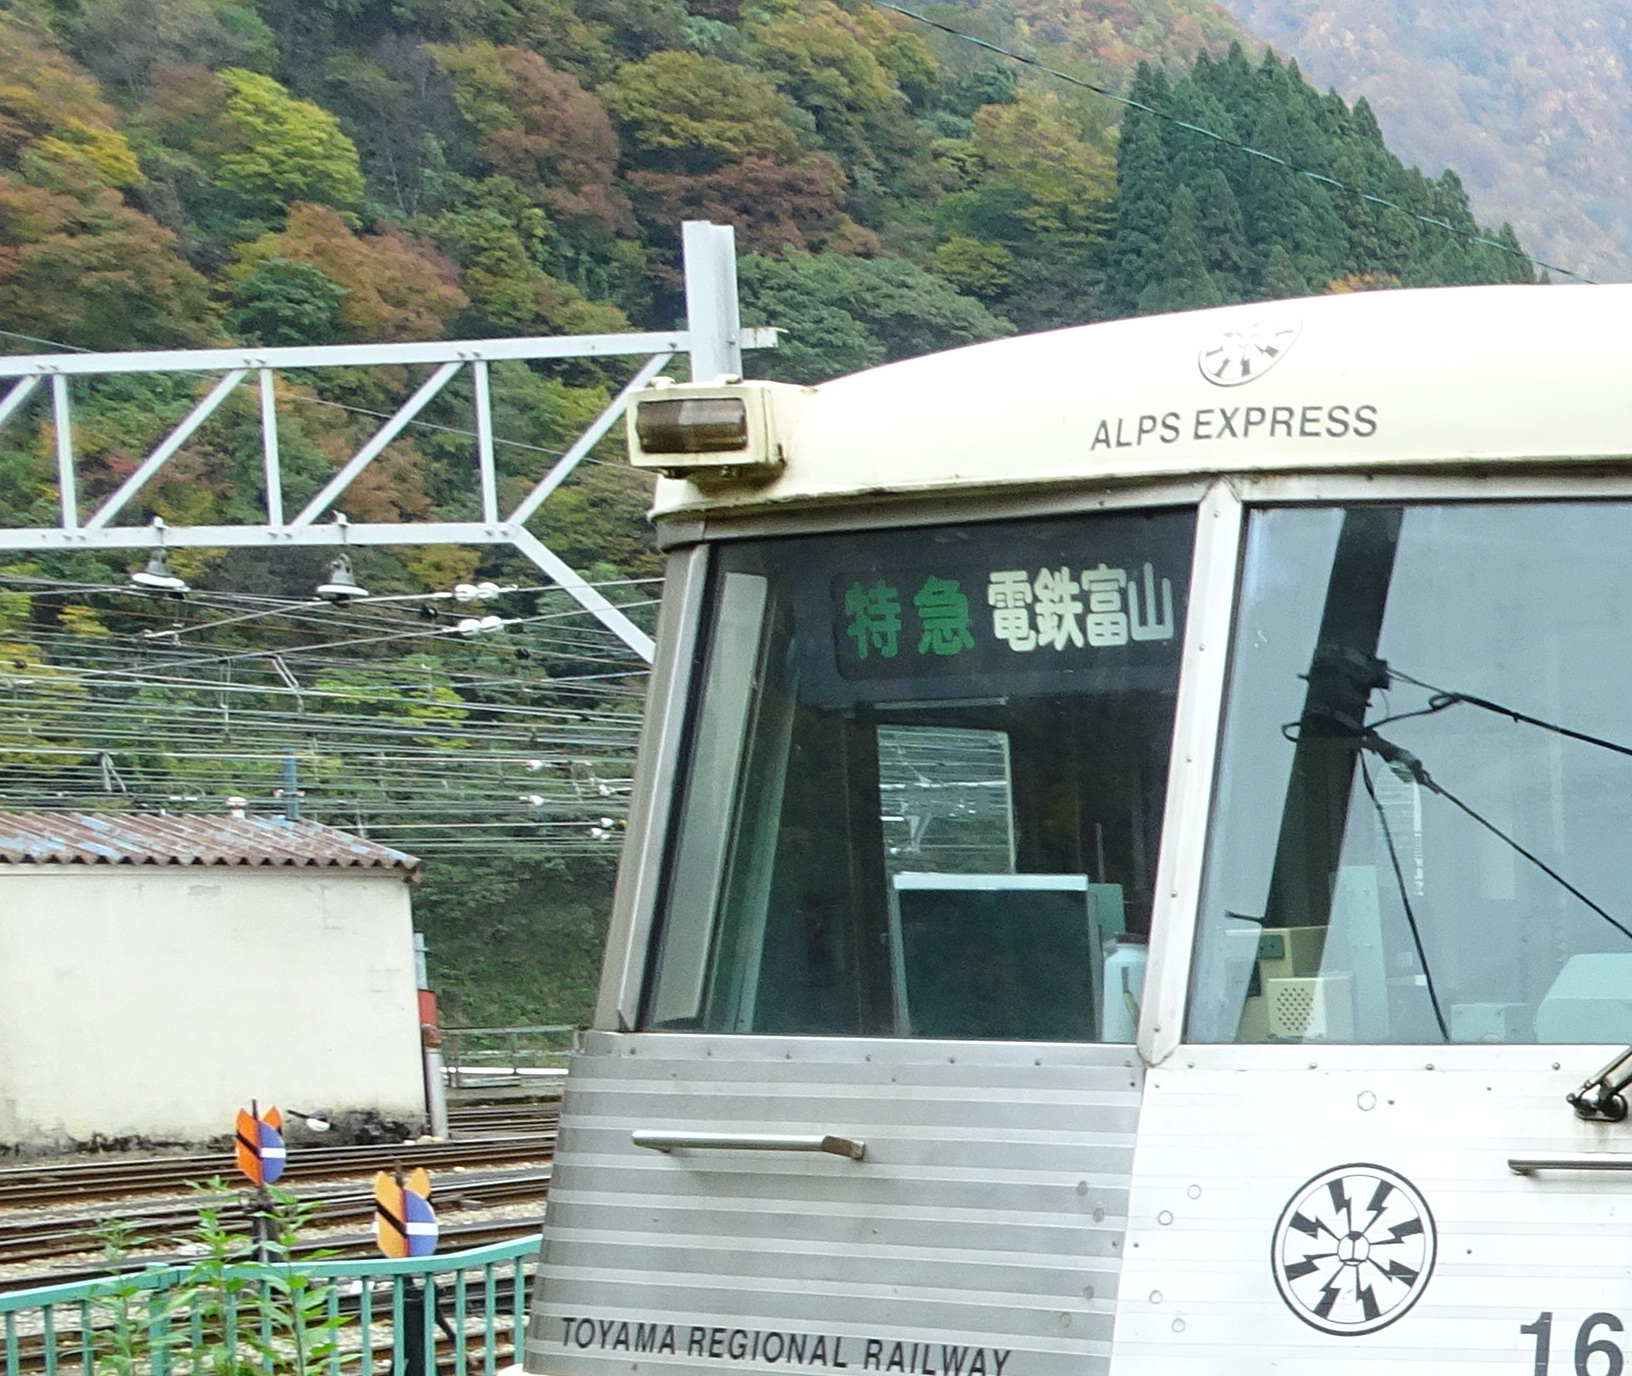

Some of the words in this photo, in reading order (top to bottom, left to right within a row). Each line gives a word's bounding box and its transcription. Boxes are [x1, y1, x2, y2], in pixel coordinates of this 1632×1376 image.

[1091, 411, 1182, 451] ALPS
[1194, 404, 1378, 441] EXPRESS
[844, 576, 974, 658] 特急
[988, 562, 1175, 651] 電鉄富山
[561, 1317, 677, 1355] TOYAMA
[688, 1327, 848, 1369] REGIONAL
